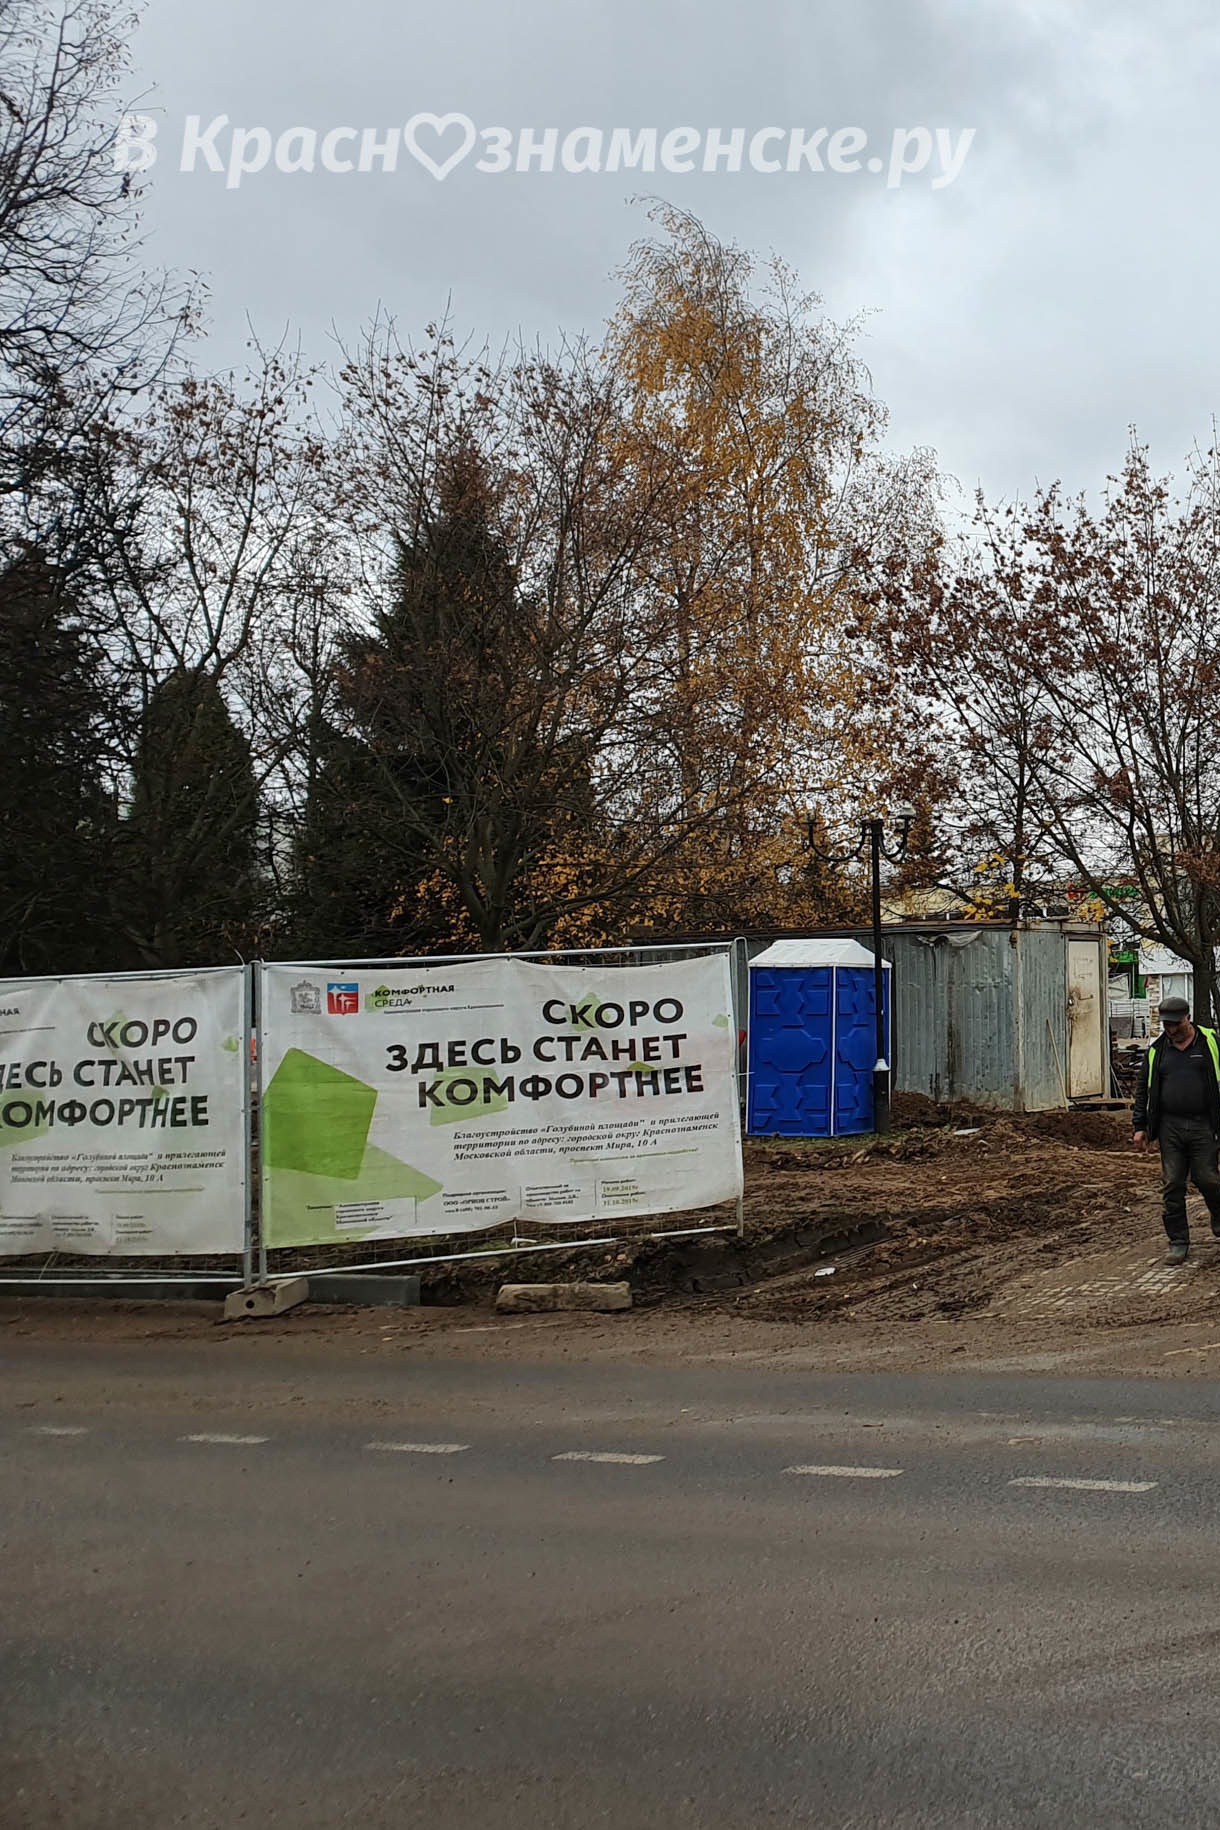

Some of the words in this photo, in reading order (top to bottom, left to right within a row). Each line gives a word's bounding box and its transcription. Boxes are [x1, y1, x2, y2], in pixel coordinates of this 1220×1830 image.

[374, 984, 455, 998] КОМФОРТНАЯ
[374, 998, 411, 1008] СРЕДА
[542, 997, 684, 1029] СКОРО
[86, 1016, 198, 1049] СКОРО
[385, 1037, 522, 1074] ЗДЕСЬ
[532, 1033, 688, 1064] СТАНЕТ
[73, 1056, 195, 1087] СТАНЕТ
[417, 1064, 705, 1108] КОМФОРТНЕЕ
[0, 1095, 209, 1128] ОМФОРТНЕЕ
